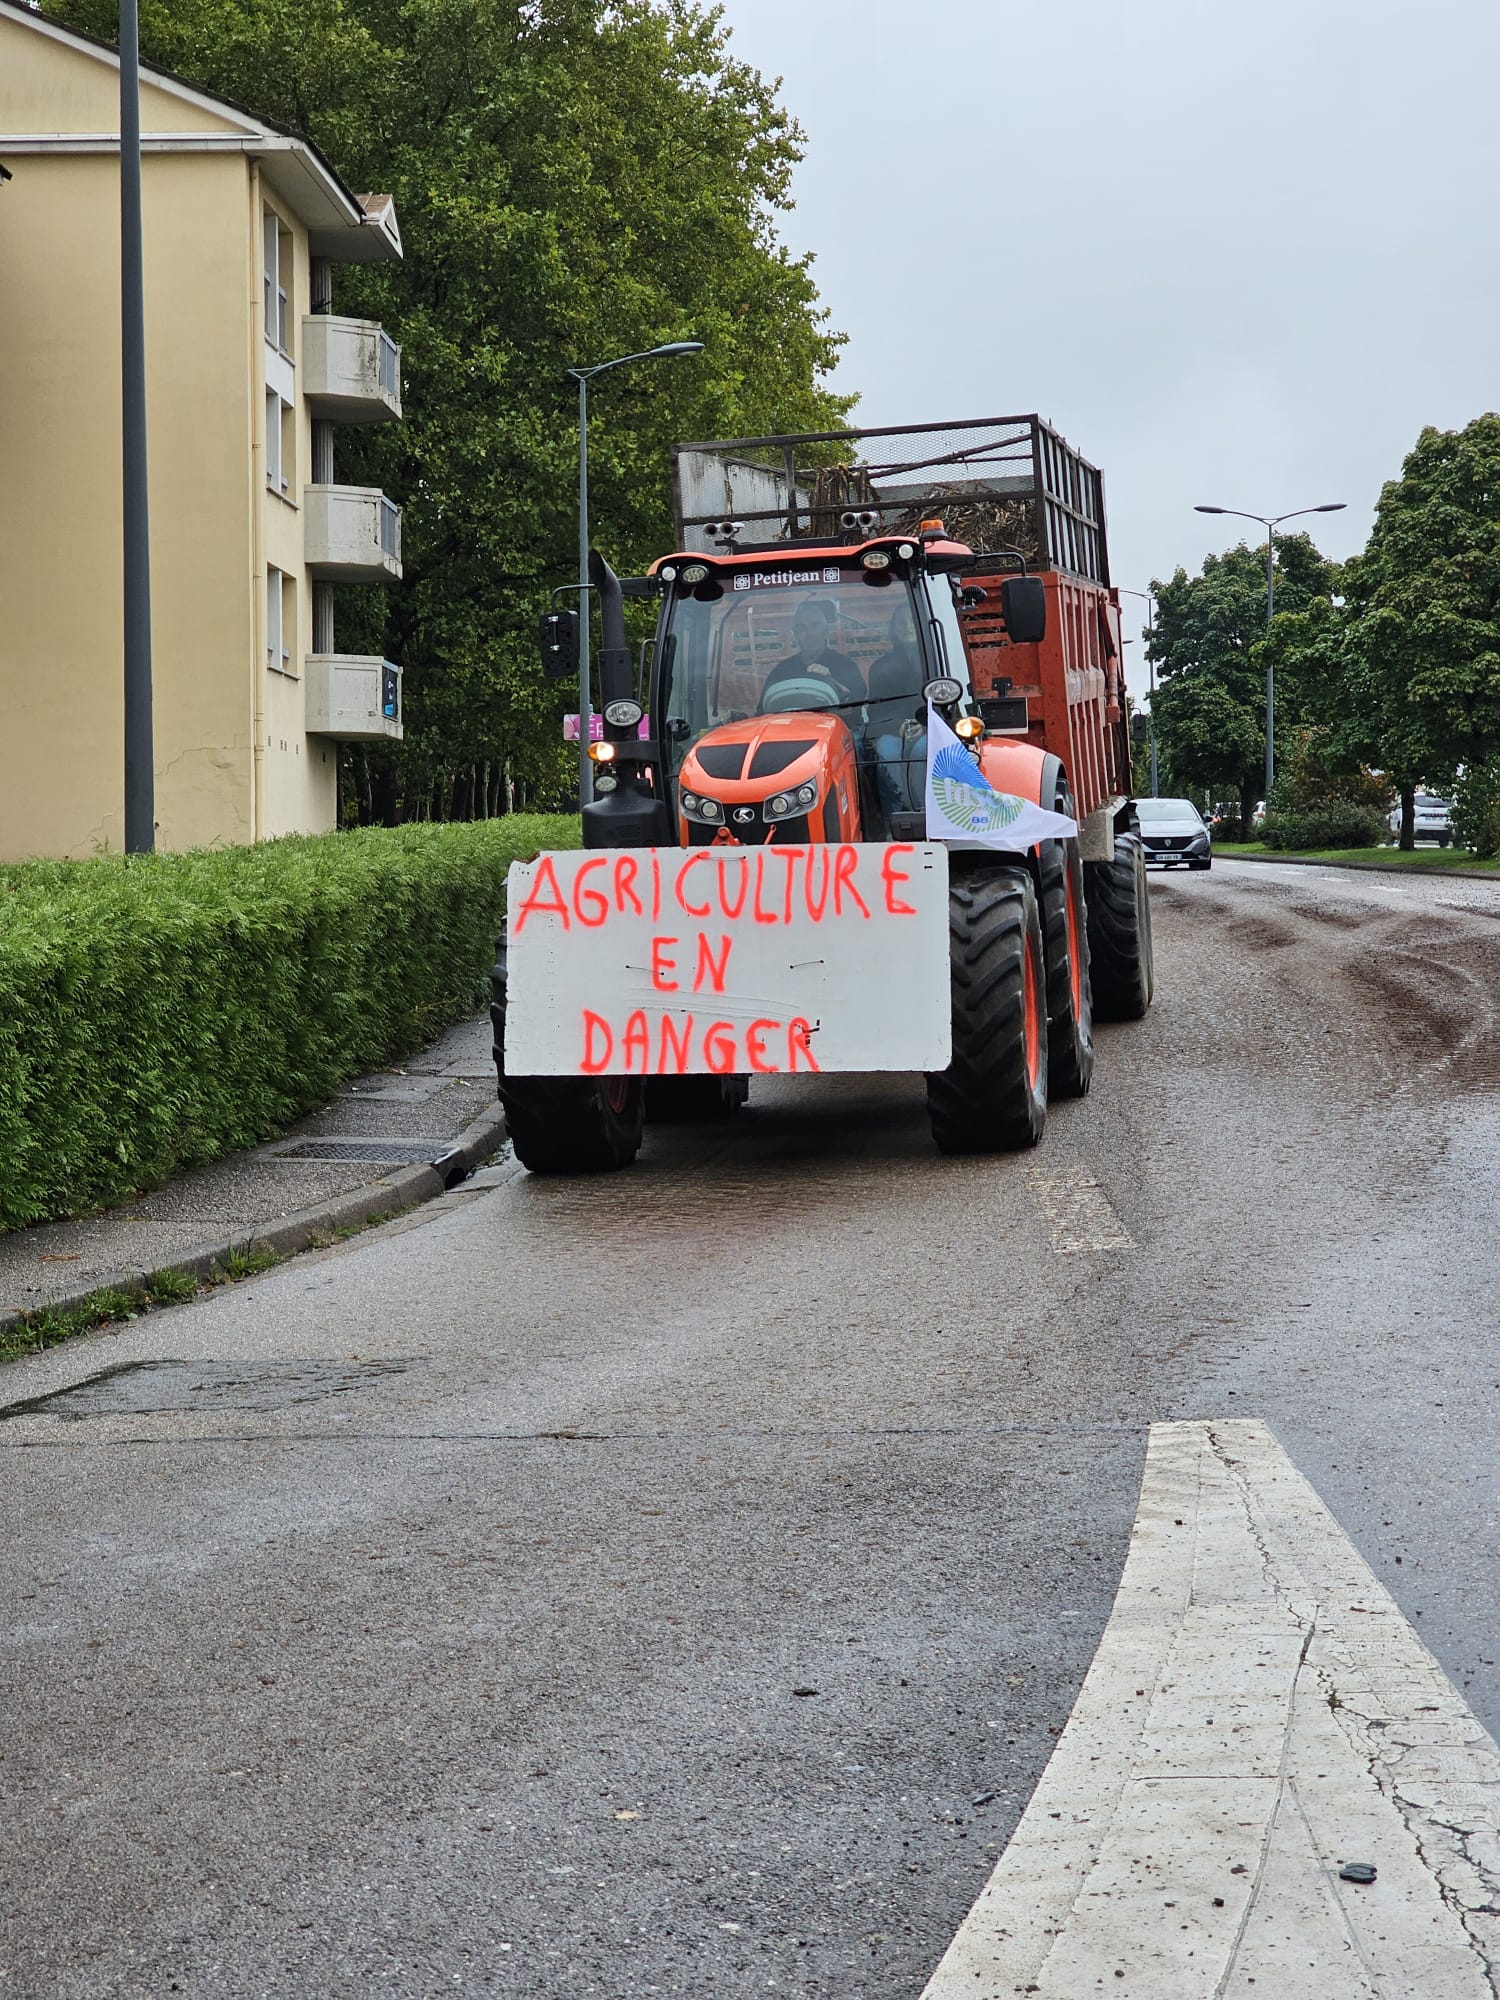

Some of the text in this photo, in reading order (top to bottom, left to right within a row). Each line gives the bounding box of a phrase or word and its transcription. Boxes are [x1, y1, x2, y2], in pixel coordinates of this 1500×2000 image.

[753, 570, 820, 587] Petitjean
[971, 816, 989, 824] 88
[515, 845, 917, 933] AGRICULTURE
[652, 932, 733, 992] EN
[580, 1009, 820, 1074] DANGER
